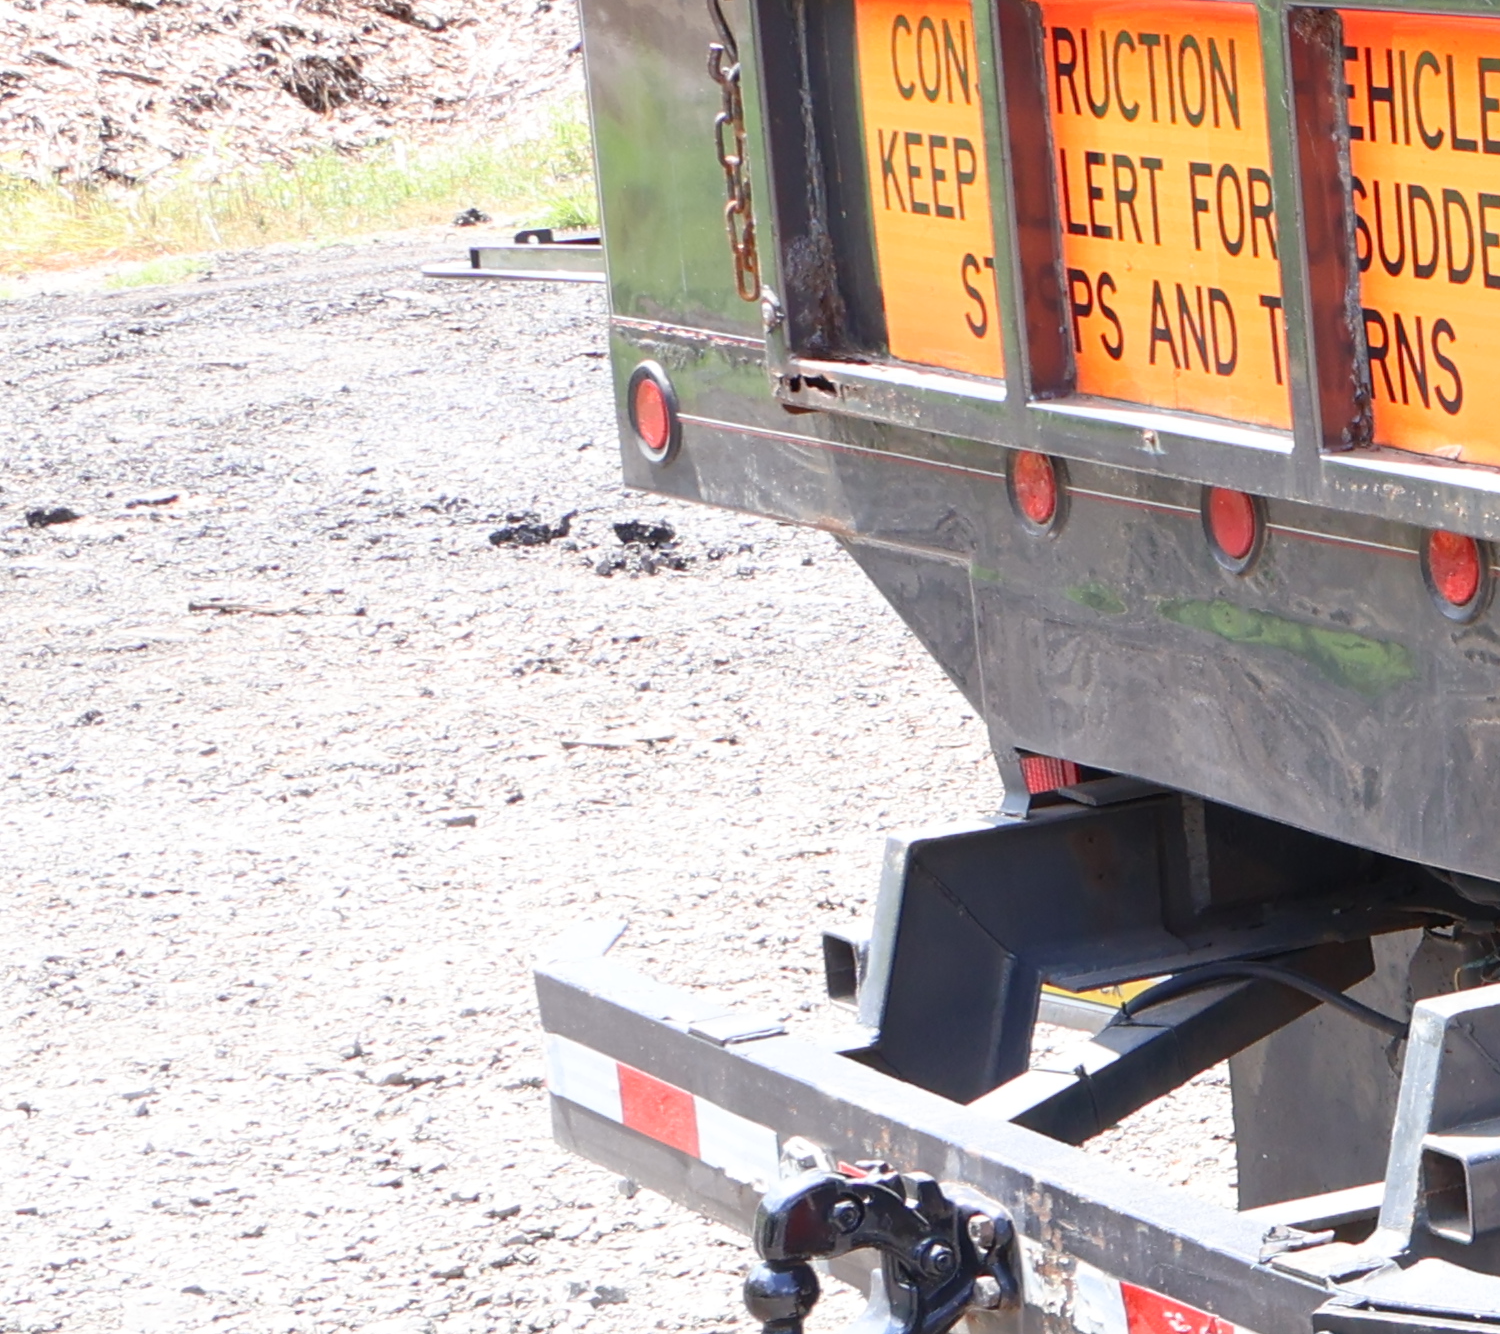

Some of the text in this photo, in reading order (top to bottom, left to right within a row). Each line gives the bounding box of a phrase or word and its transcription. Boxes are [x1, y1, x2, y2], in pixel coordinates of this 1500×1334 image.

[891, 14, 1241, 130] CONRUCTION
[878, 128, 977, 221] KEEP
[1059, 148, 1163, 246] LERT
[1189, 161, 1278, 261] FOR
[961, 253, 1463, 416] SPS AND TRNS
